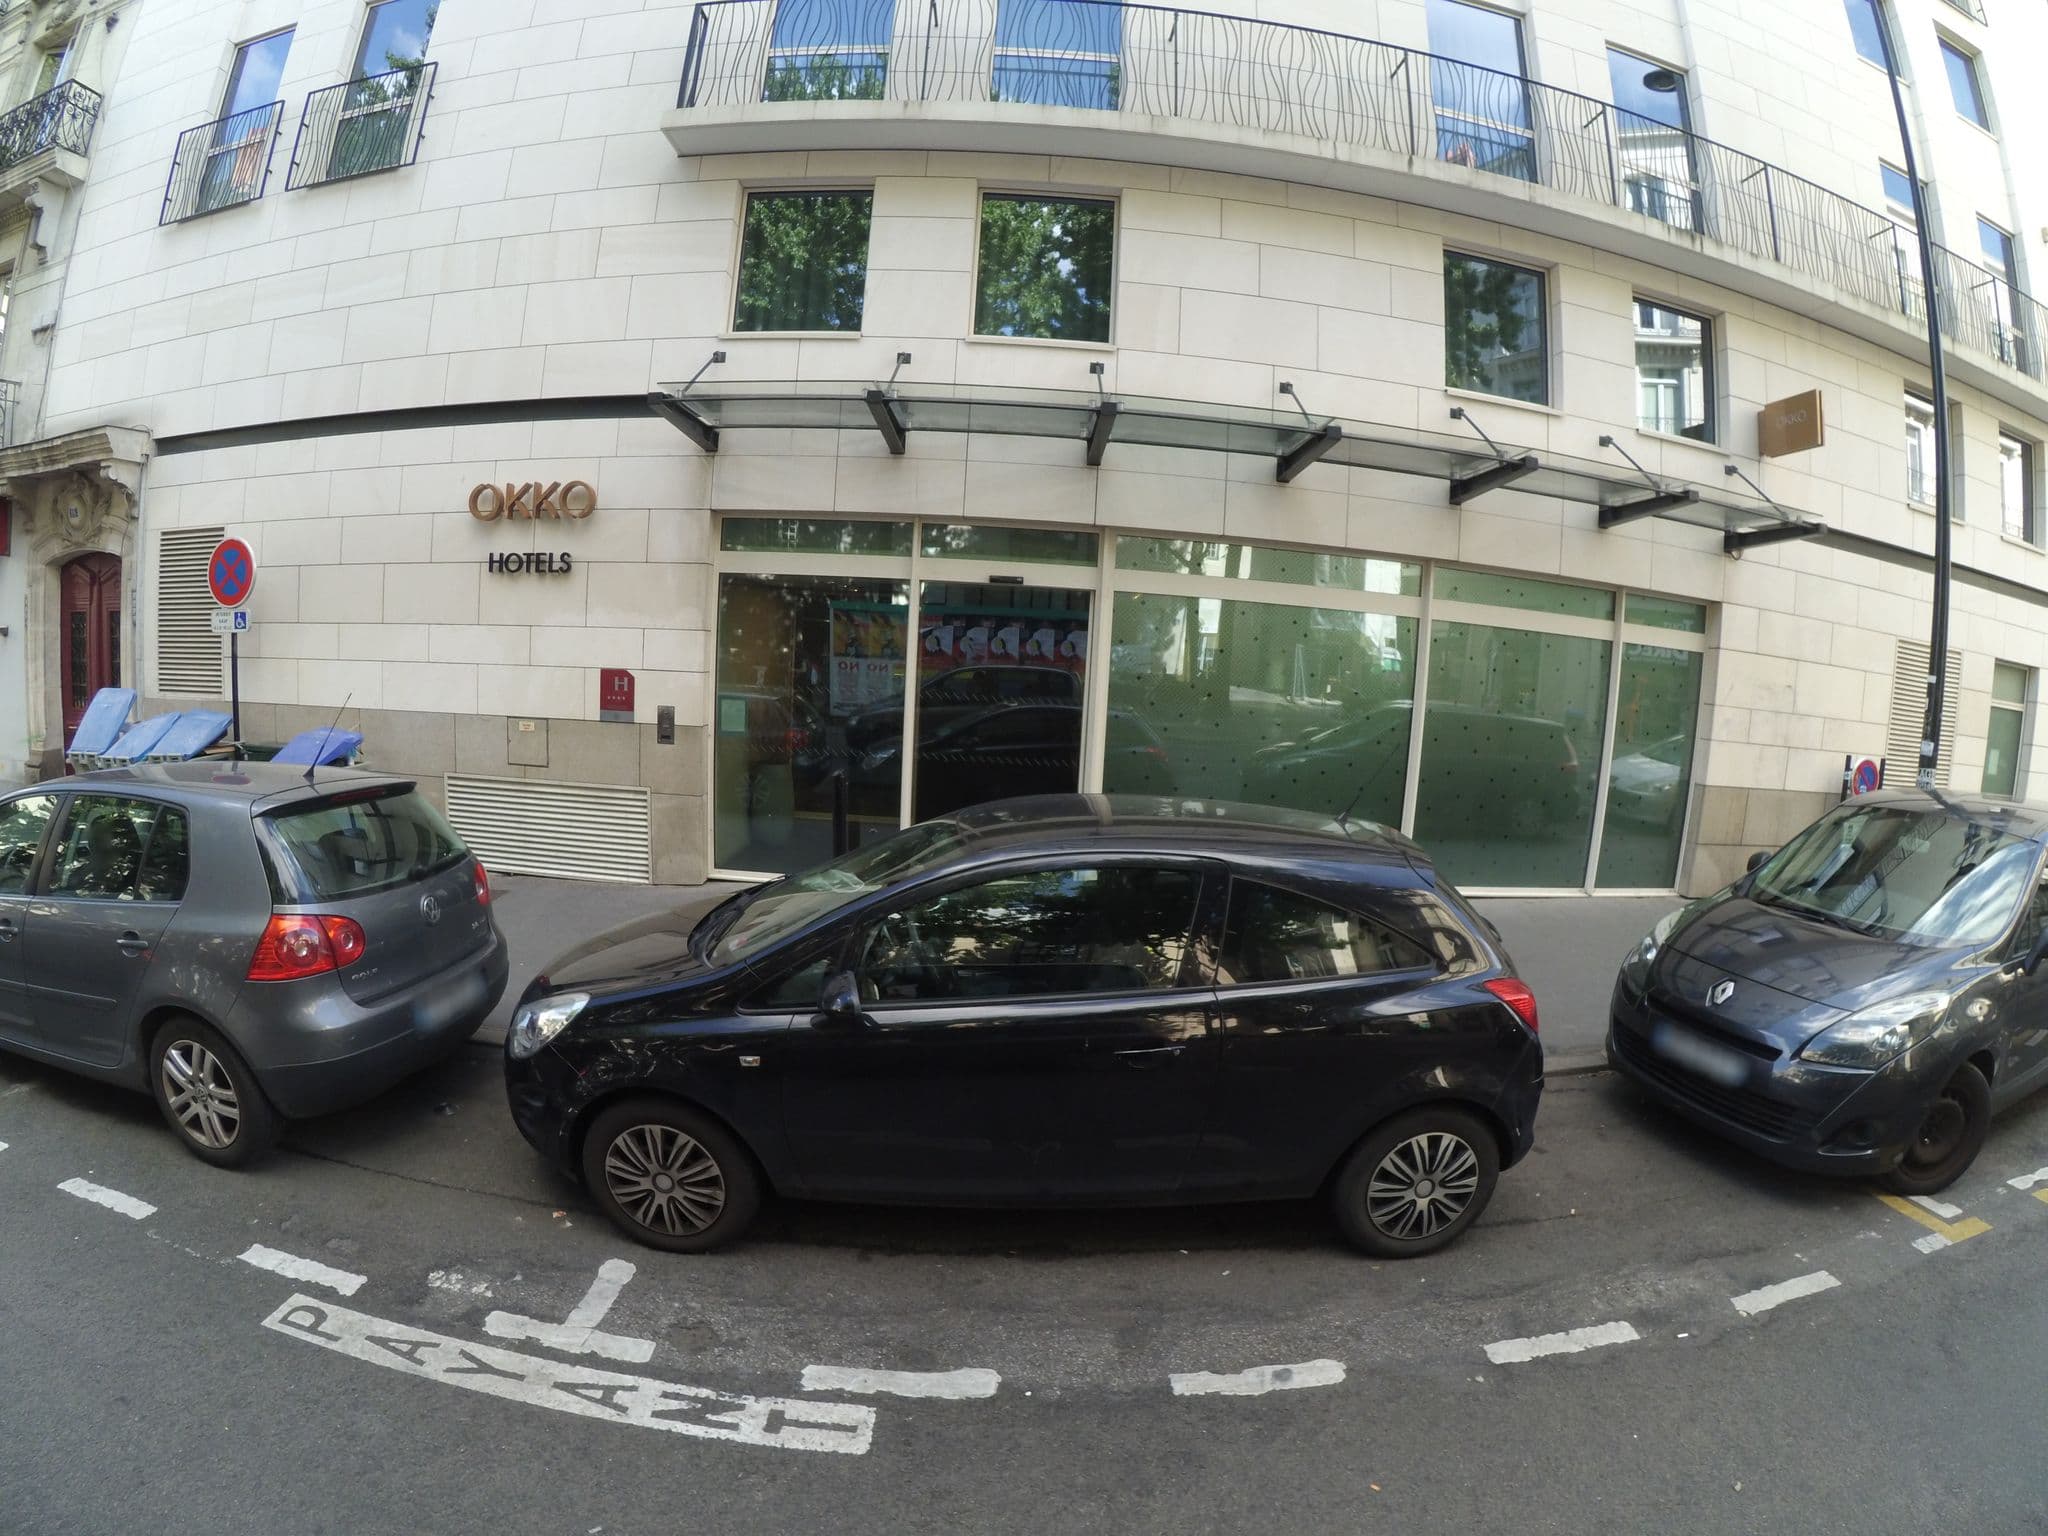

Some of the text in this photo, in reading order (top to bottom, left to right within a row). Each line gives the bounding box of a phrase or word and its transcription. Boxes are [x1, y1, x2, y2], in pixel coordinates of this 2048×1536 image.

[469, 480, 597, 521] OKKO
[488, 552, 572, 573] HOTELS
[614, 676, 629, 691] H
[279, 1304, 859, 1434] PAYANT
